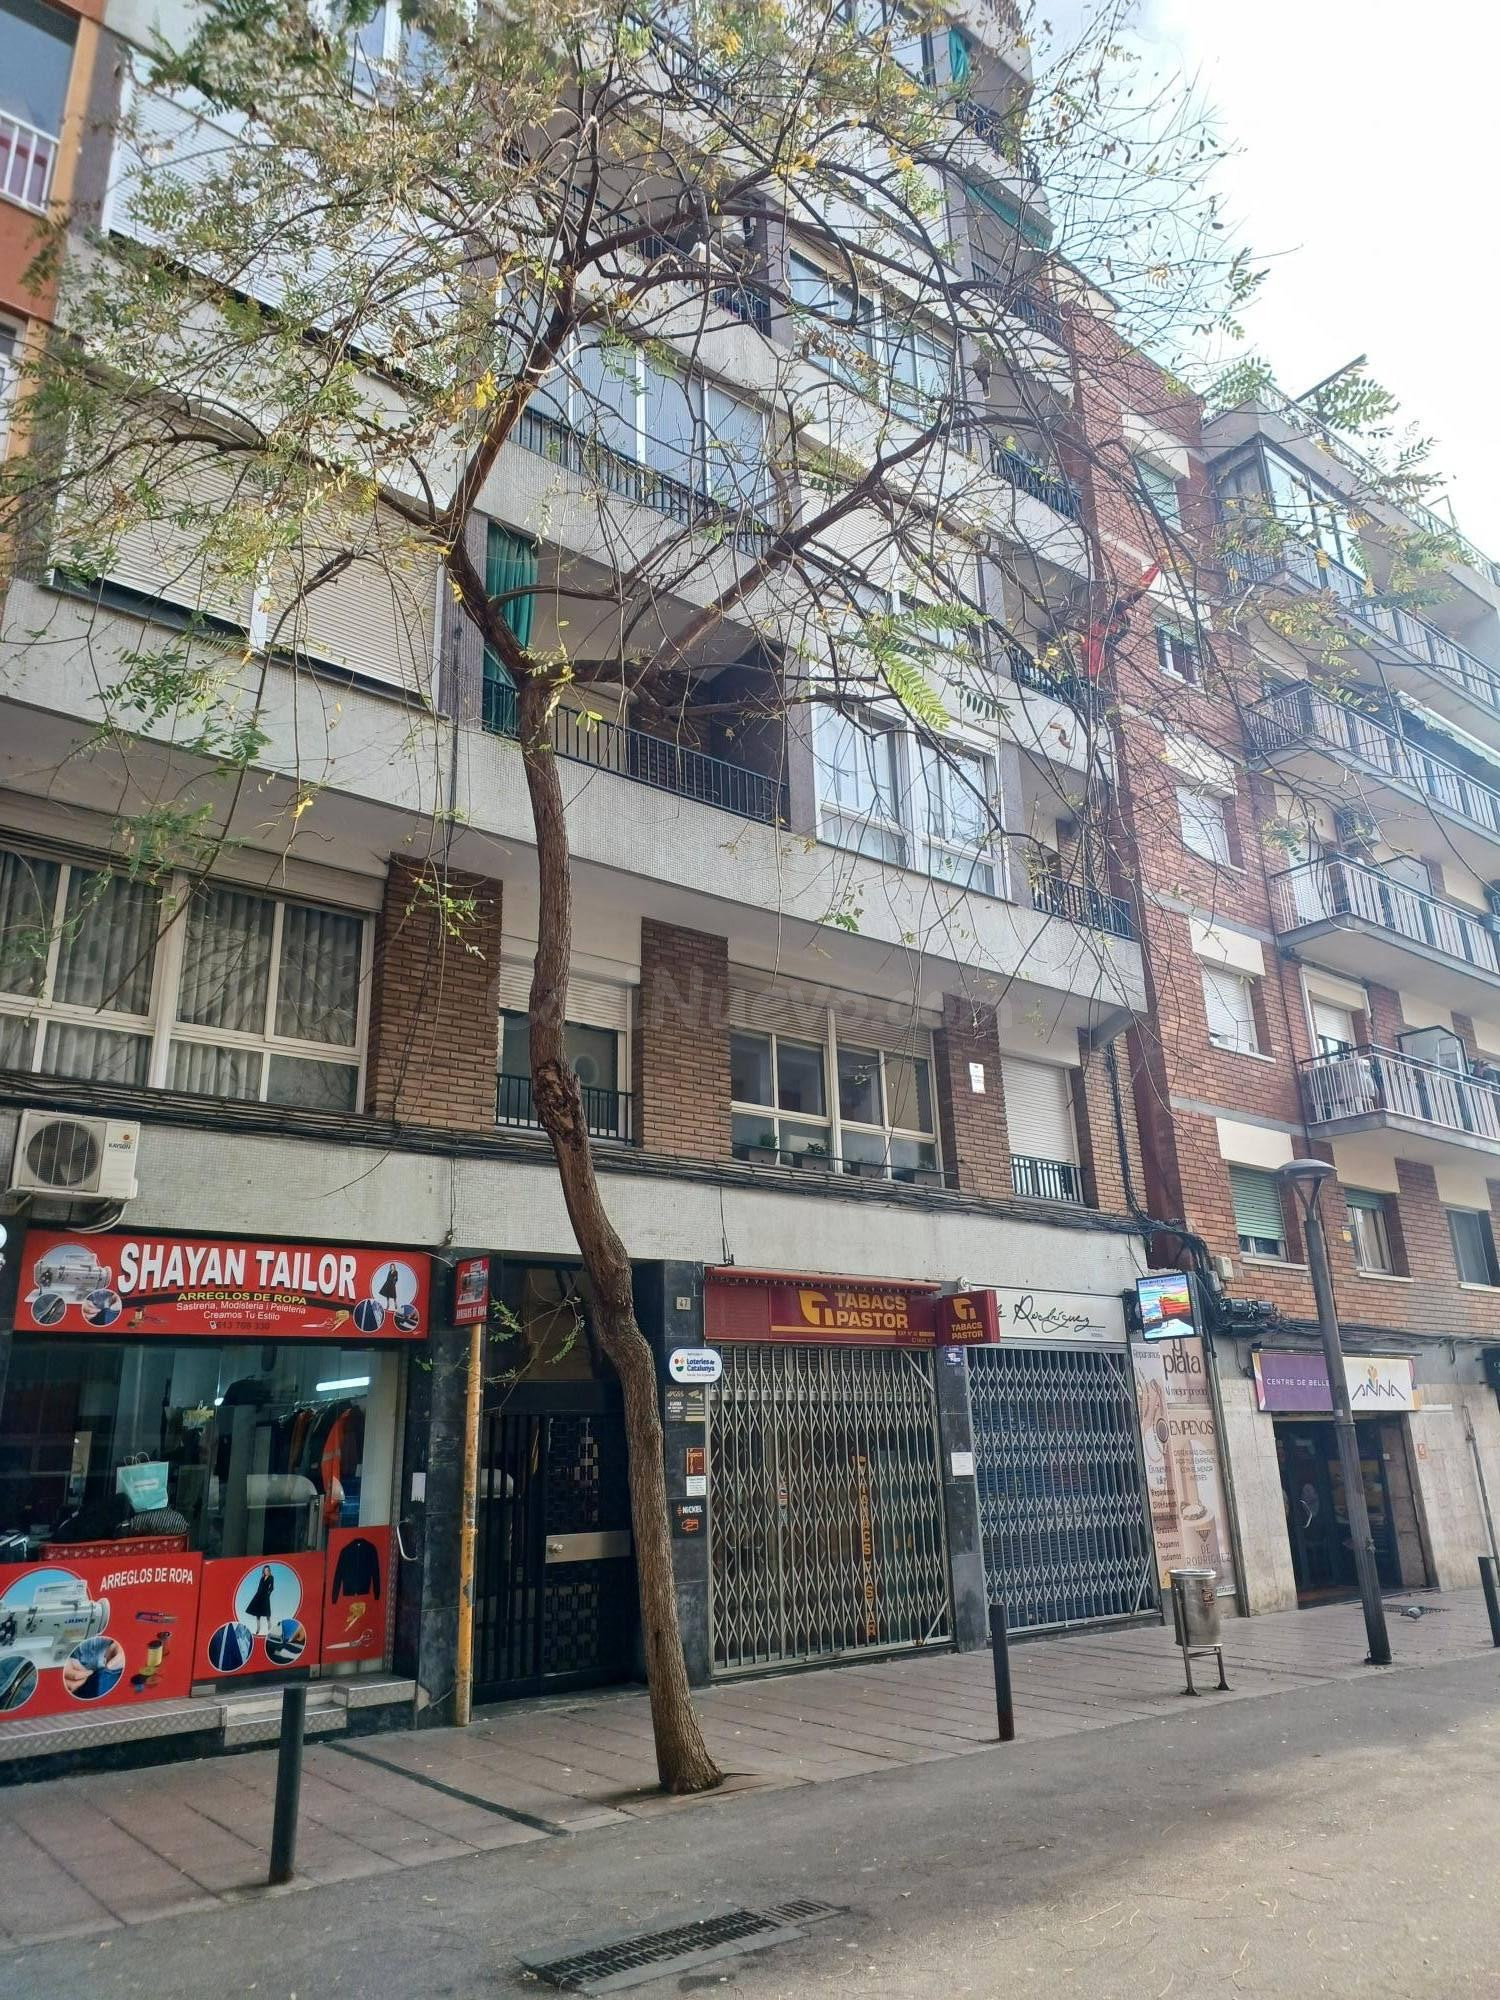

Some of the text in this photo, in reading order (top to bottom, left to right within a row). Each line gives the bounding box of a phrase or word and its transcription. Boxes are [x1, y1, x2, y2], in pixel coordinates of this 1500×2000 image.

[118, 1243, 358, 1299] SHAYAN TAILOR
[177, 1291, 308, 1306] ARREGLOS DE ROPA
[834, 1291, 907, 1311] TABACS
[203, 1310, 281, 1321] Creamos Tu Estilo
[836, 1311, 909, 1329] PASTOR
[951, 1321, 983, 1331] TABACS
[951, 1331, 983, 1340] PASTOR
[687, 1357, 709, 1365] Loteries
[687, 1365, 715, 1373] Catalunya
[1266, 1377, 1295, 1387] CENTRE
[1296, 1378, 1306, 1387] DE
[682, 1505, 703, 1514] NICKEL
[100, 1567, 193, 1592] ARREGLOS DE ROPA
